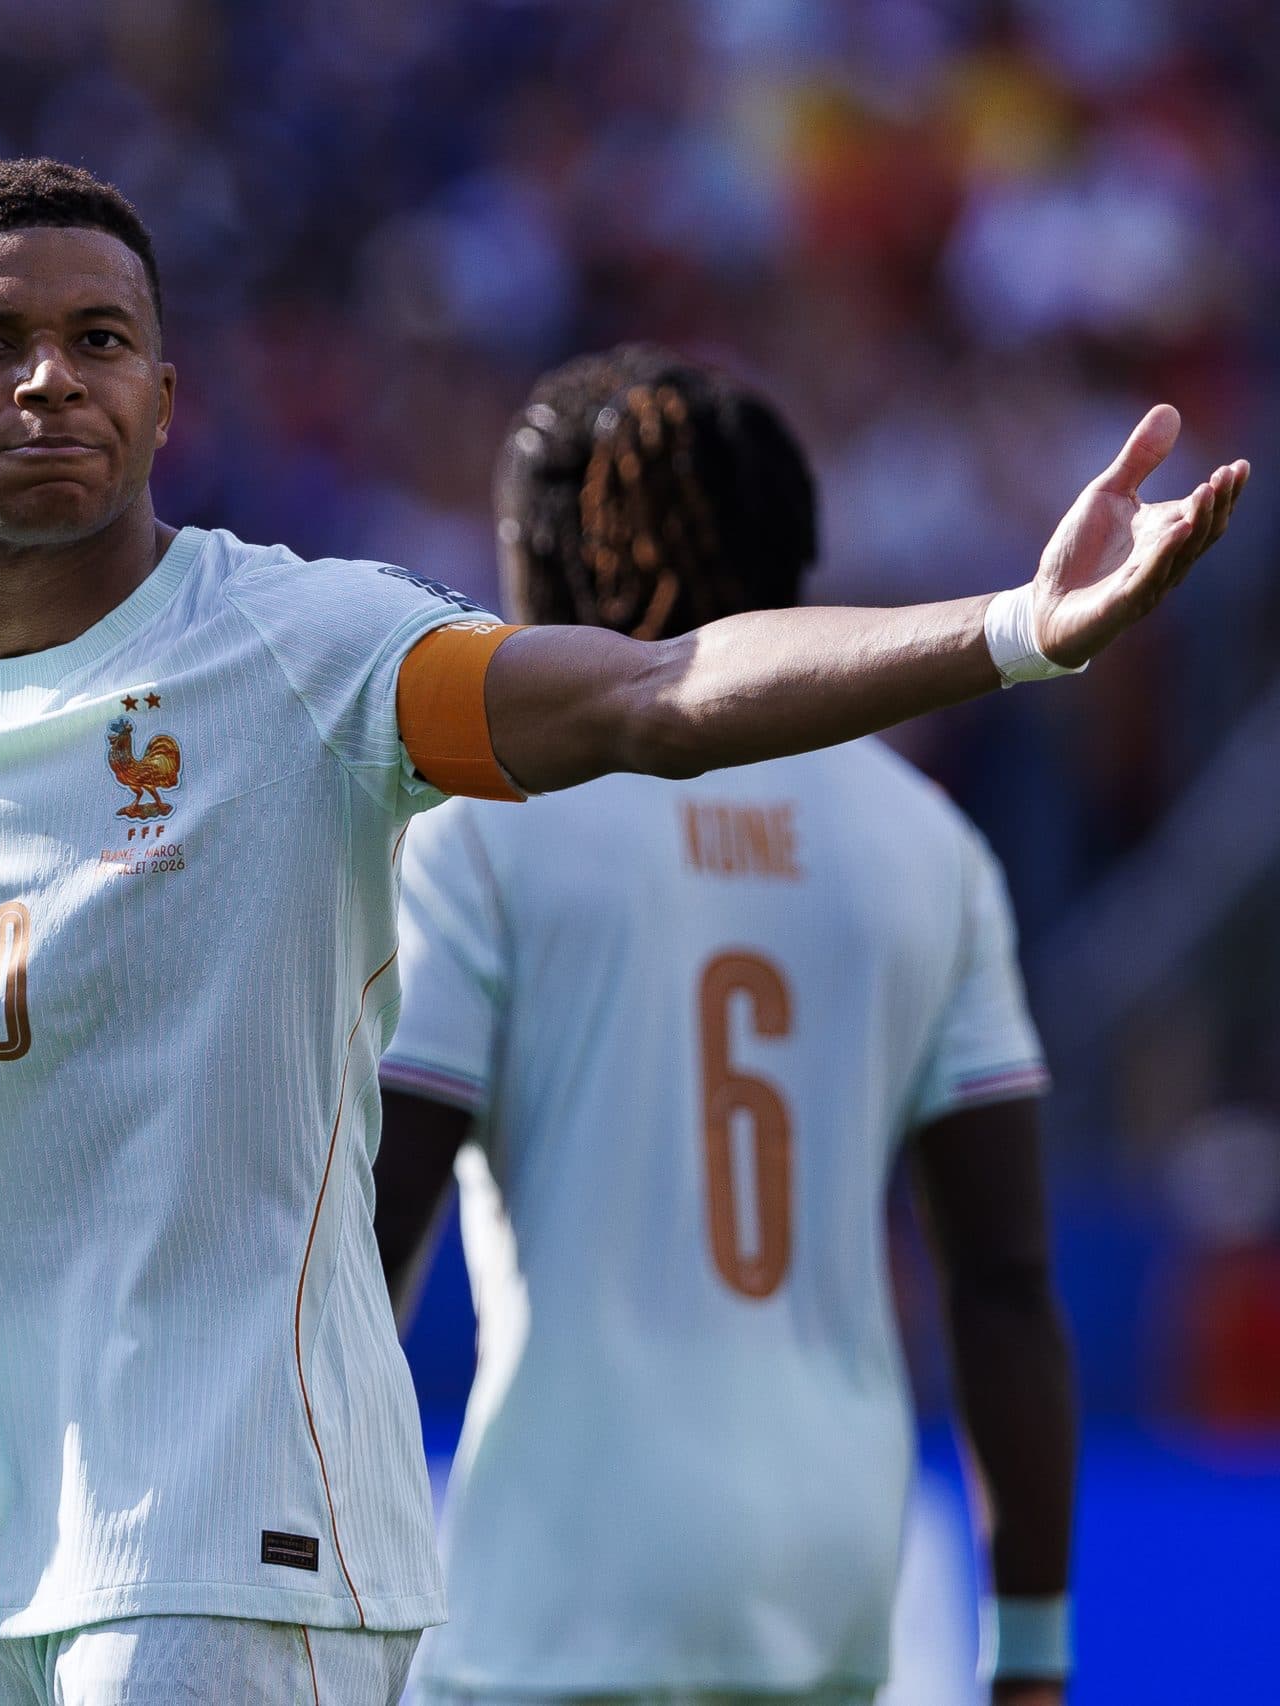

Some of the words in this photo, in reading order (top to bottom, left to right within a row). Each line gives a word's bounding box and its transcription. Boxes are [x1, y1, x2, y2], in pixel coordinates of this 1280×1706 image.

[127, 825, 165, 841] FFF
[144, 844, 184, 858] MAROC
[150, 858, 186, 873] 2026
[698, 948, 793, 1301] 6
